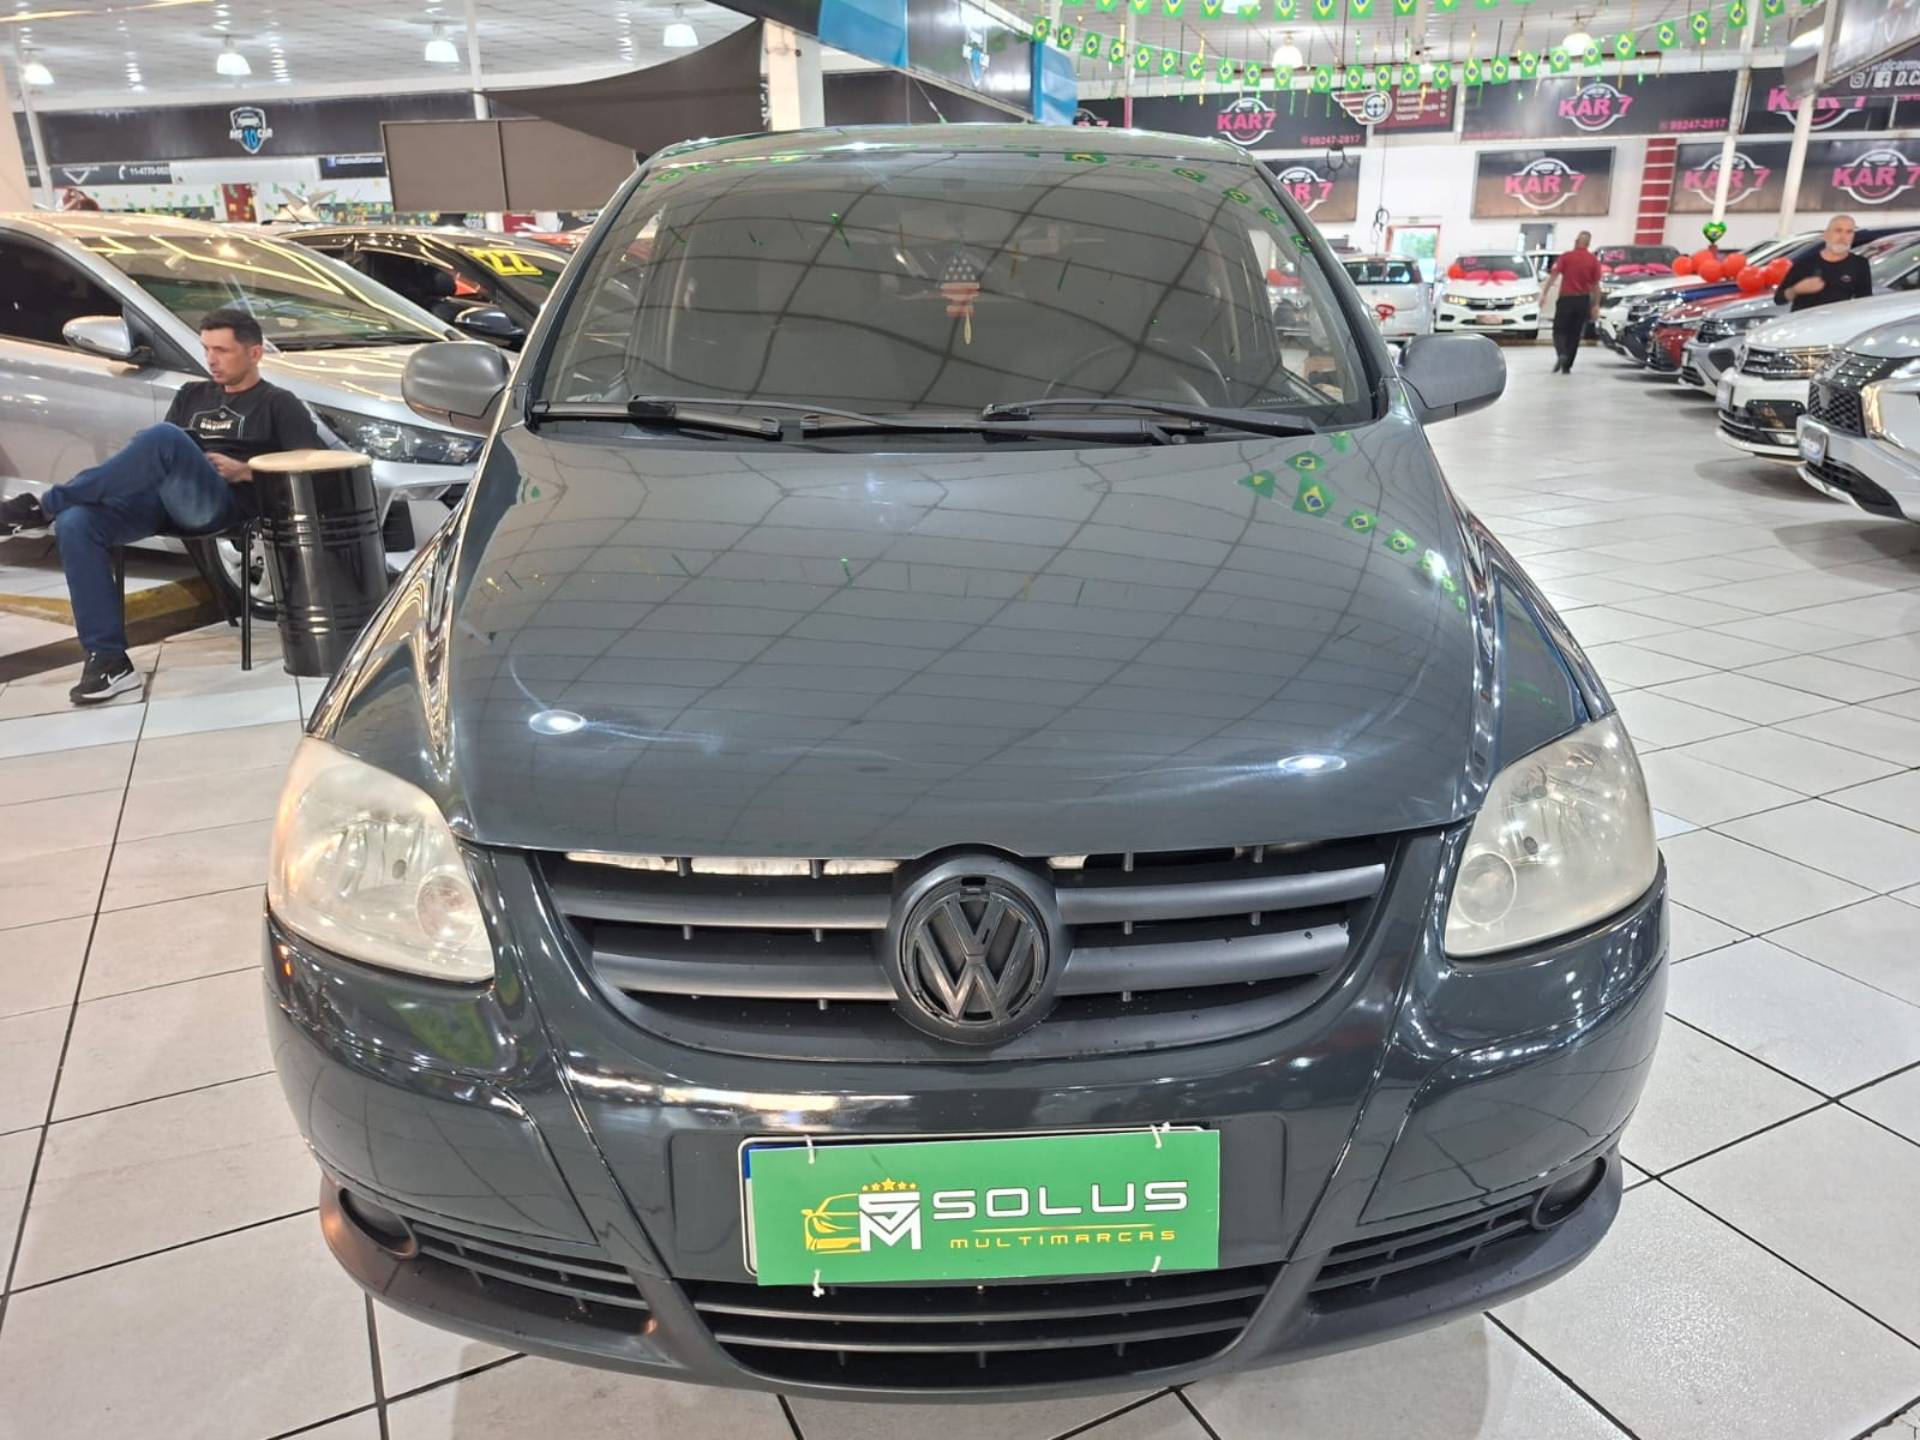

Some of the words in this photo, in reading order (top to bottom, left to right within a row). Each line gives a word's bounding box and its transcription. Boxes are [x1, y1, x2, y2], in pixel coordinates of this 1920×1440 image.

[1559, 97, 1611, 116] KAR
[1619, 95, 1633, 113] 7
[1216, 112, 1264, 130] KAR
[1264, 111, 1277, 129] 7
[1504, 175, 1560, 194] KAR
[1569, 173, 1585, 193] 7
[1754, 167, 1771, 188] 7
[1832, 166, 1896, 188] KAR
[1906, 166, 1920, 186] 7
[1318, 182, 1334, 200] 7
[932, 1180, 1189, 1221] SOLUS
[950, 1230, 1176, 1250] MULTIMARCAS
